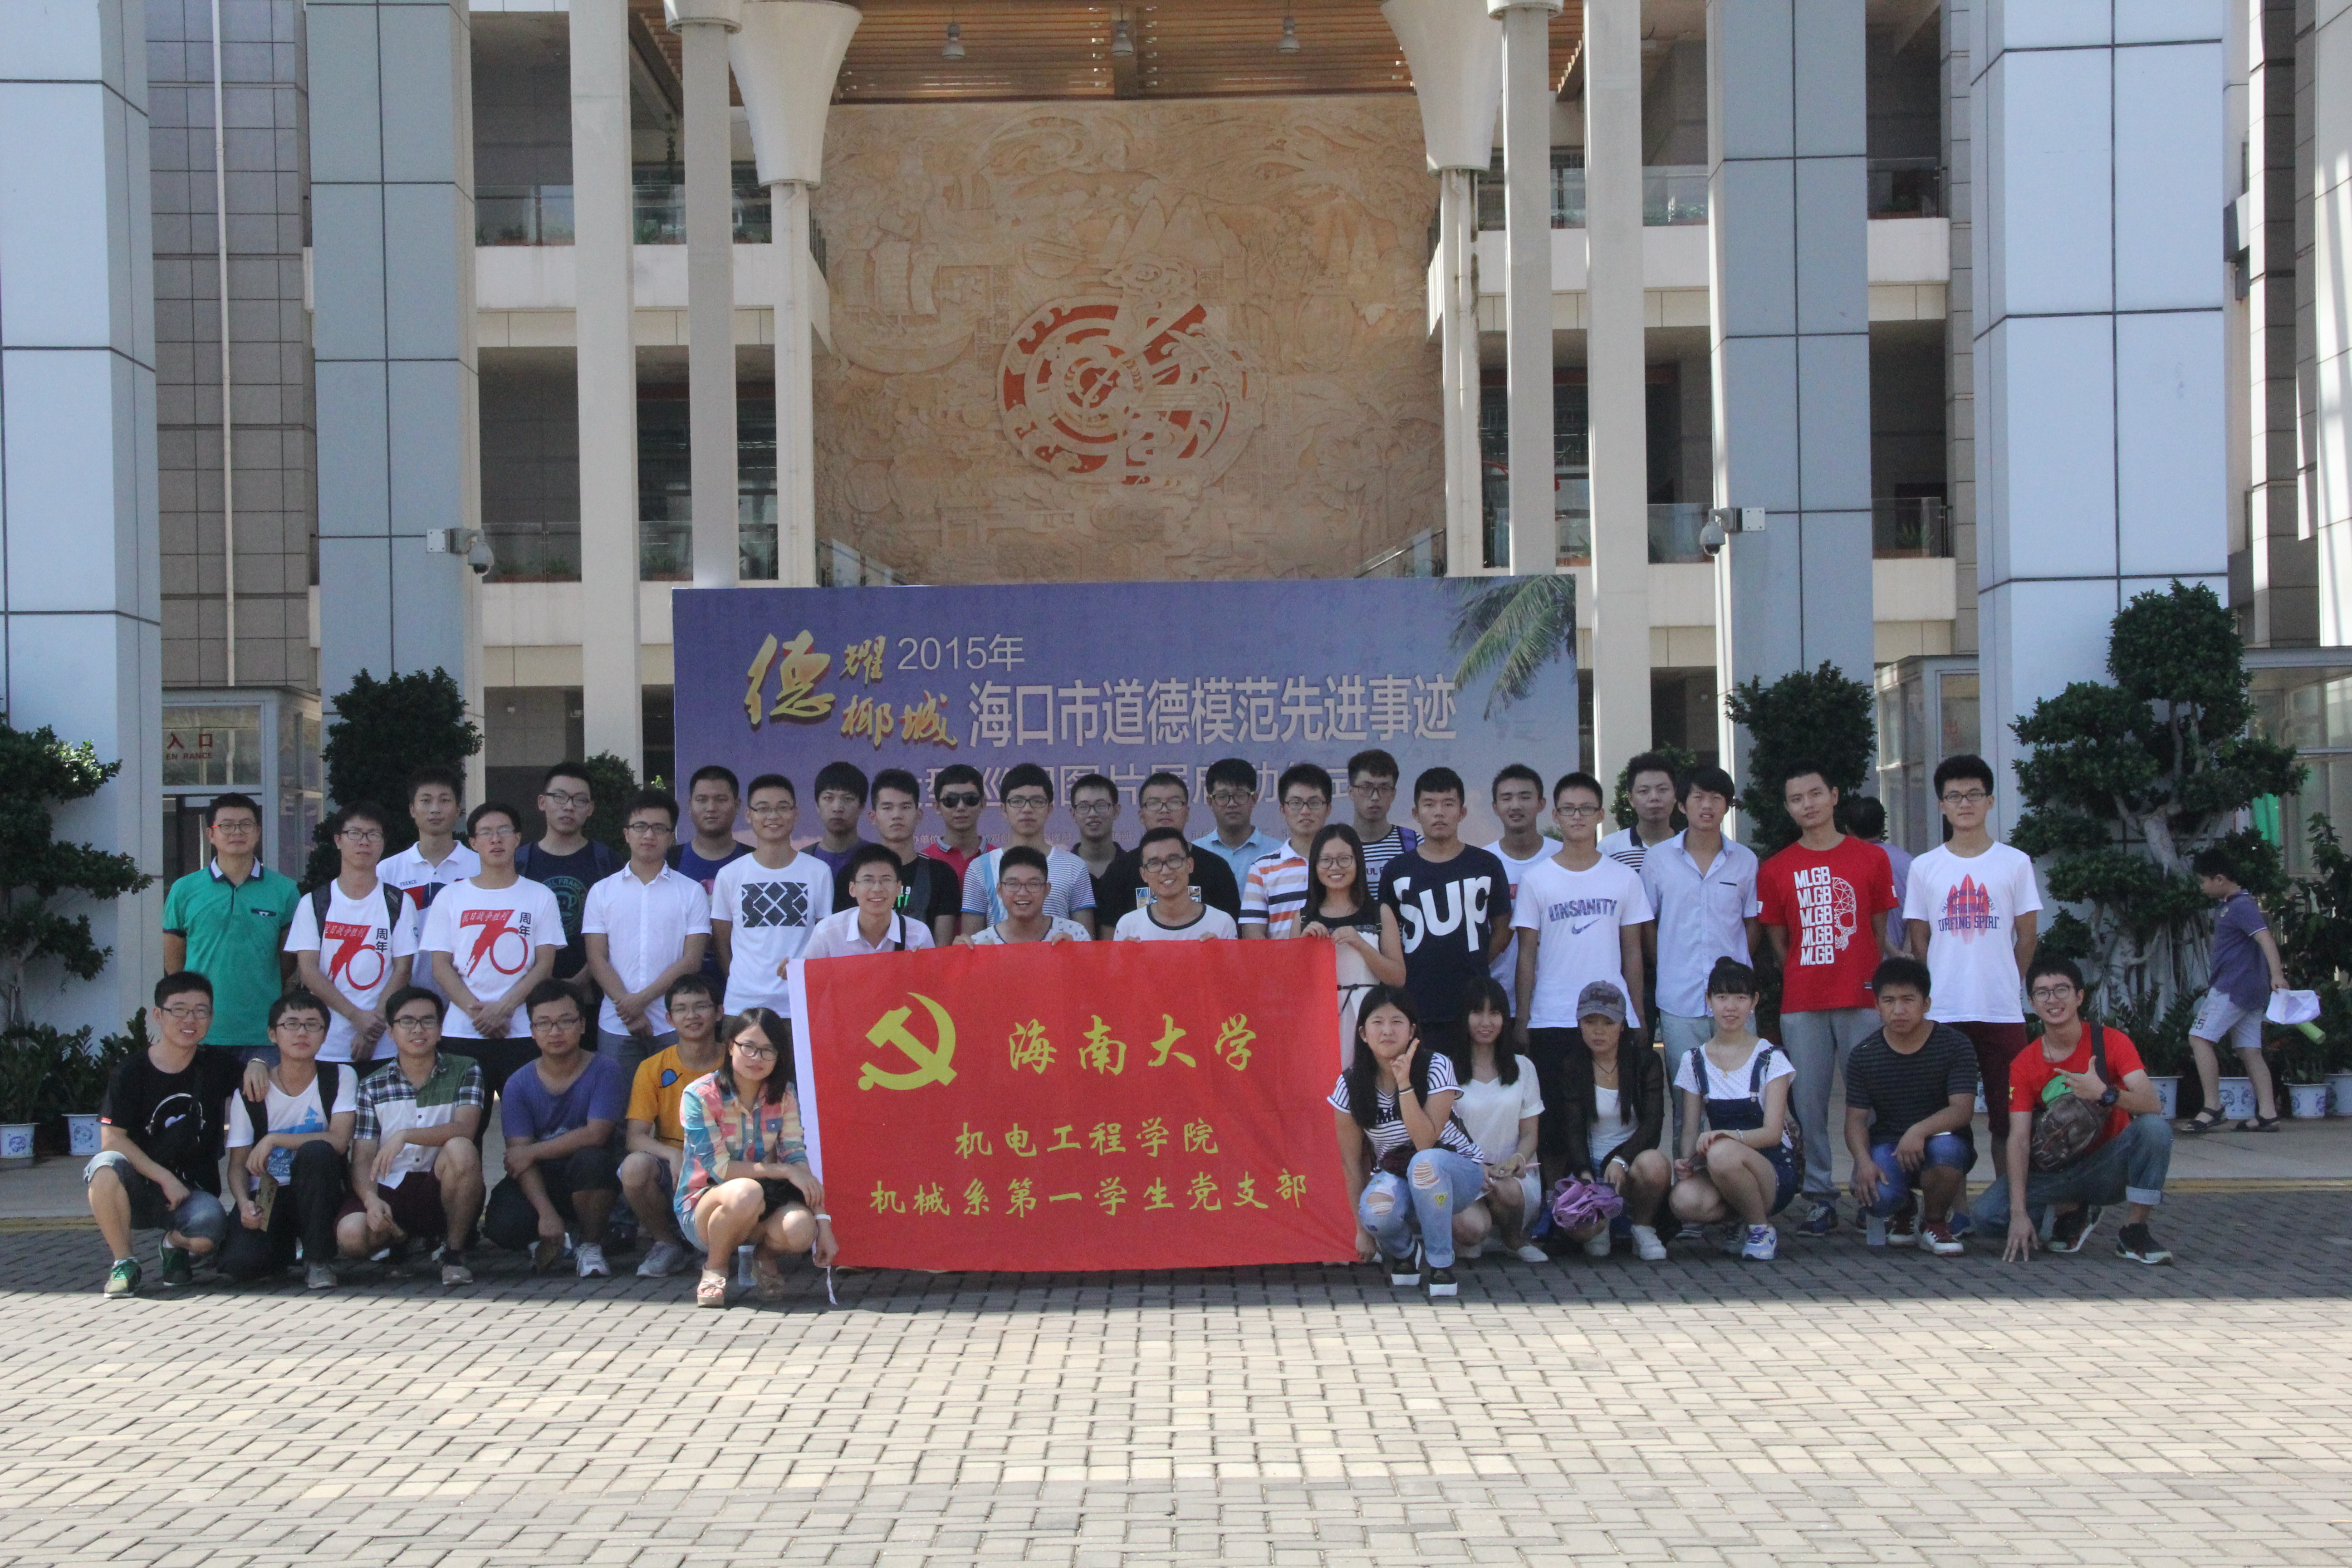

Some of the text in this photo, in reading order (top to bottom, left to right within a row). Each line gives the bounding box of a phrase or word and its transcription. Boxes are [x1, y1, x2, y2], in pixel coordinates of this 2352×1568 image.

[897, 633, 1026, 671] 2015年
[969, 674, 1457, 747] 海口市道德模范先进事迹
[167, 733, 213, 749] 入口
[1793, 866, 1831, 889] MLGB
[1797, 886, 1832, 908] MLGB
[462, 910, 510, 923] 抗日战争胜利
[519, 912, 531, 937] 周年
[1799, 905, 1833, 927] MLGB
[375, 928, 388, 953] 周年
[1801, 925, 1834, 947] MLGB
[1800, 945, 1834, 965] MLGB
[1009, 1013, 1257, 1075] 海南大学
[955, 1117, 1219, 1160] 机电工程学院
[870, 1167, 1307, 1218] 机械系第一学生党支部
